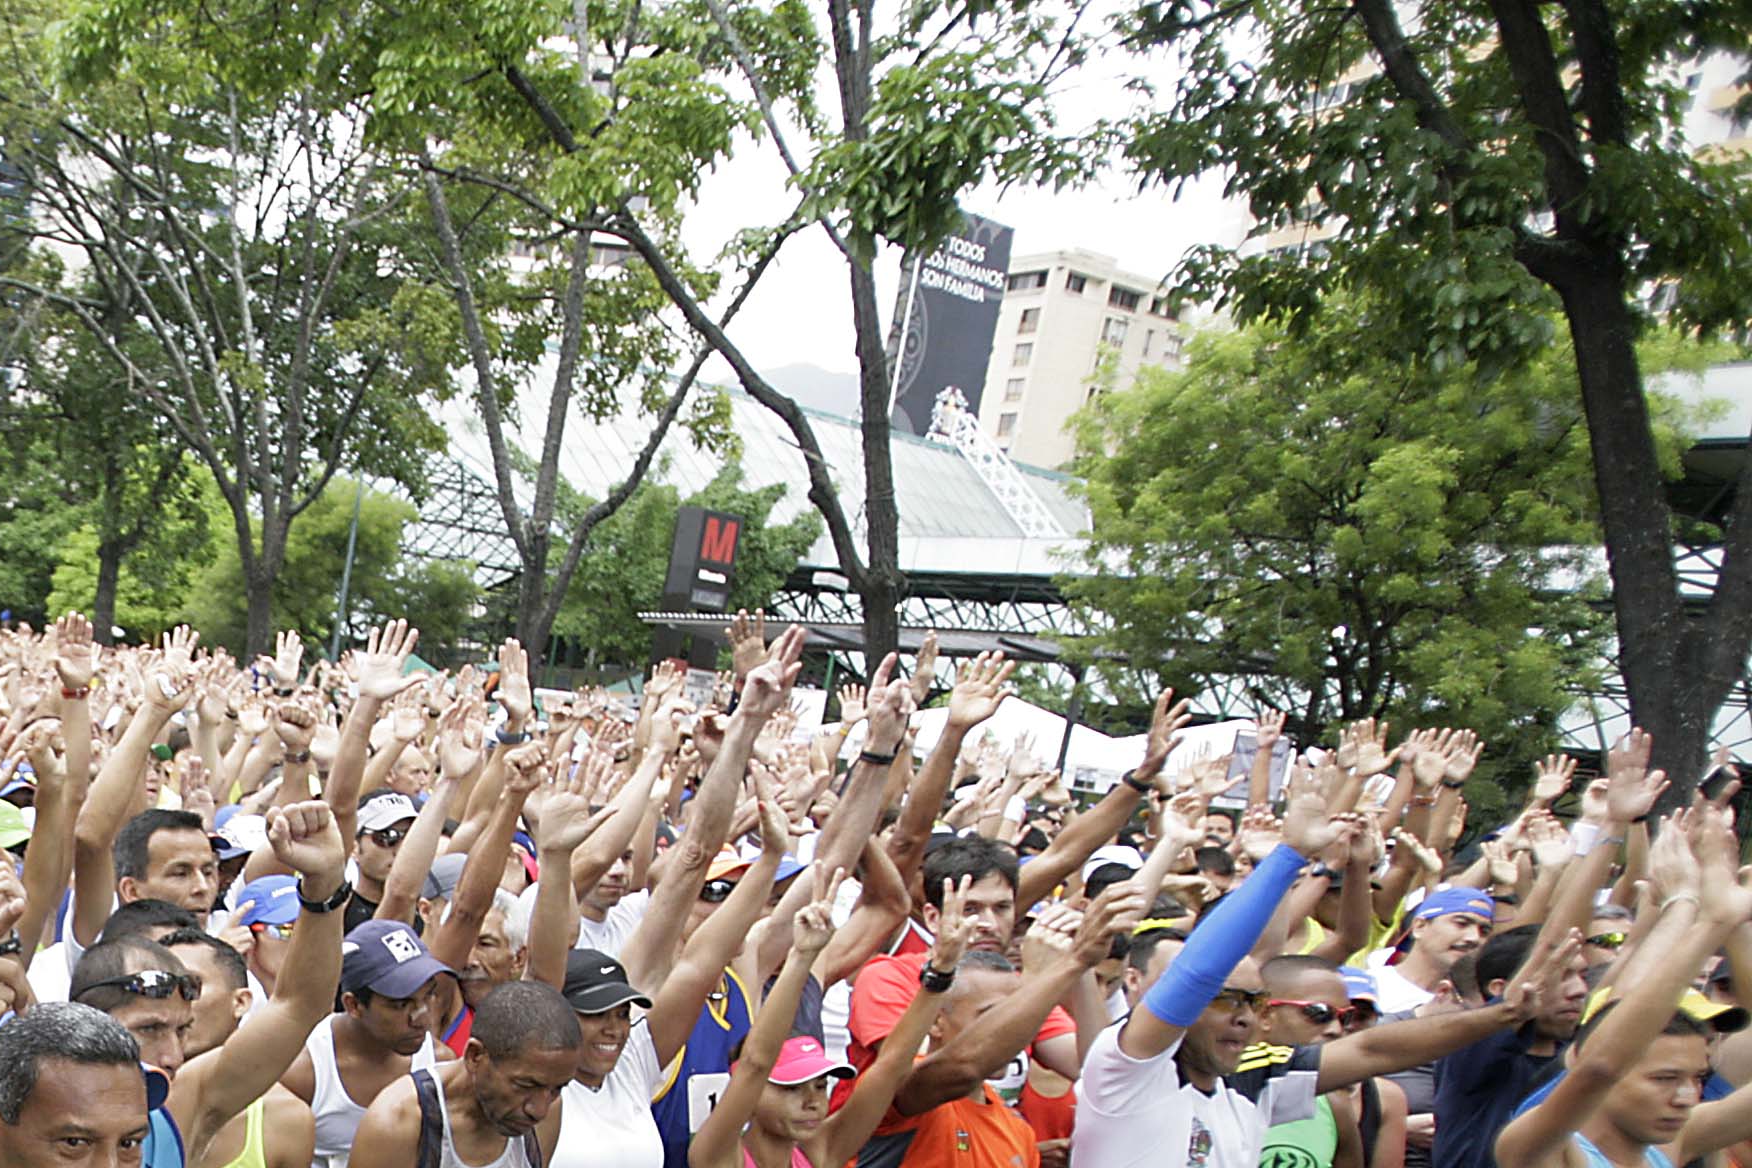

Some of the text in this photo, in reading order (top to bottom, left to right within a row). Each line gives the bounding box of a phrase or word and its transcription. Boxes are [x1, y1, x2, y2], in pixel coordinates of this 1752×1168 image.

[949, 236, 986, 262] TODOS
[921, 267, 985, 303] SON FAMILIA
[945, 255, 1005, 288] HERMANOS
[701, 517, 739, 565] M
